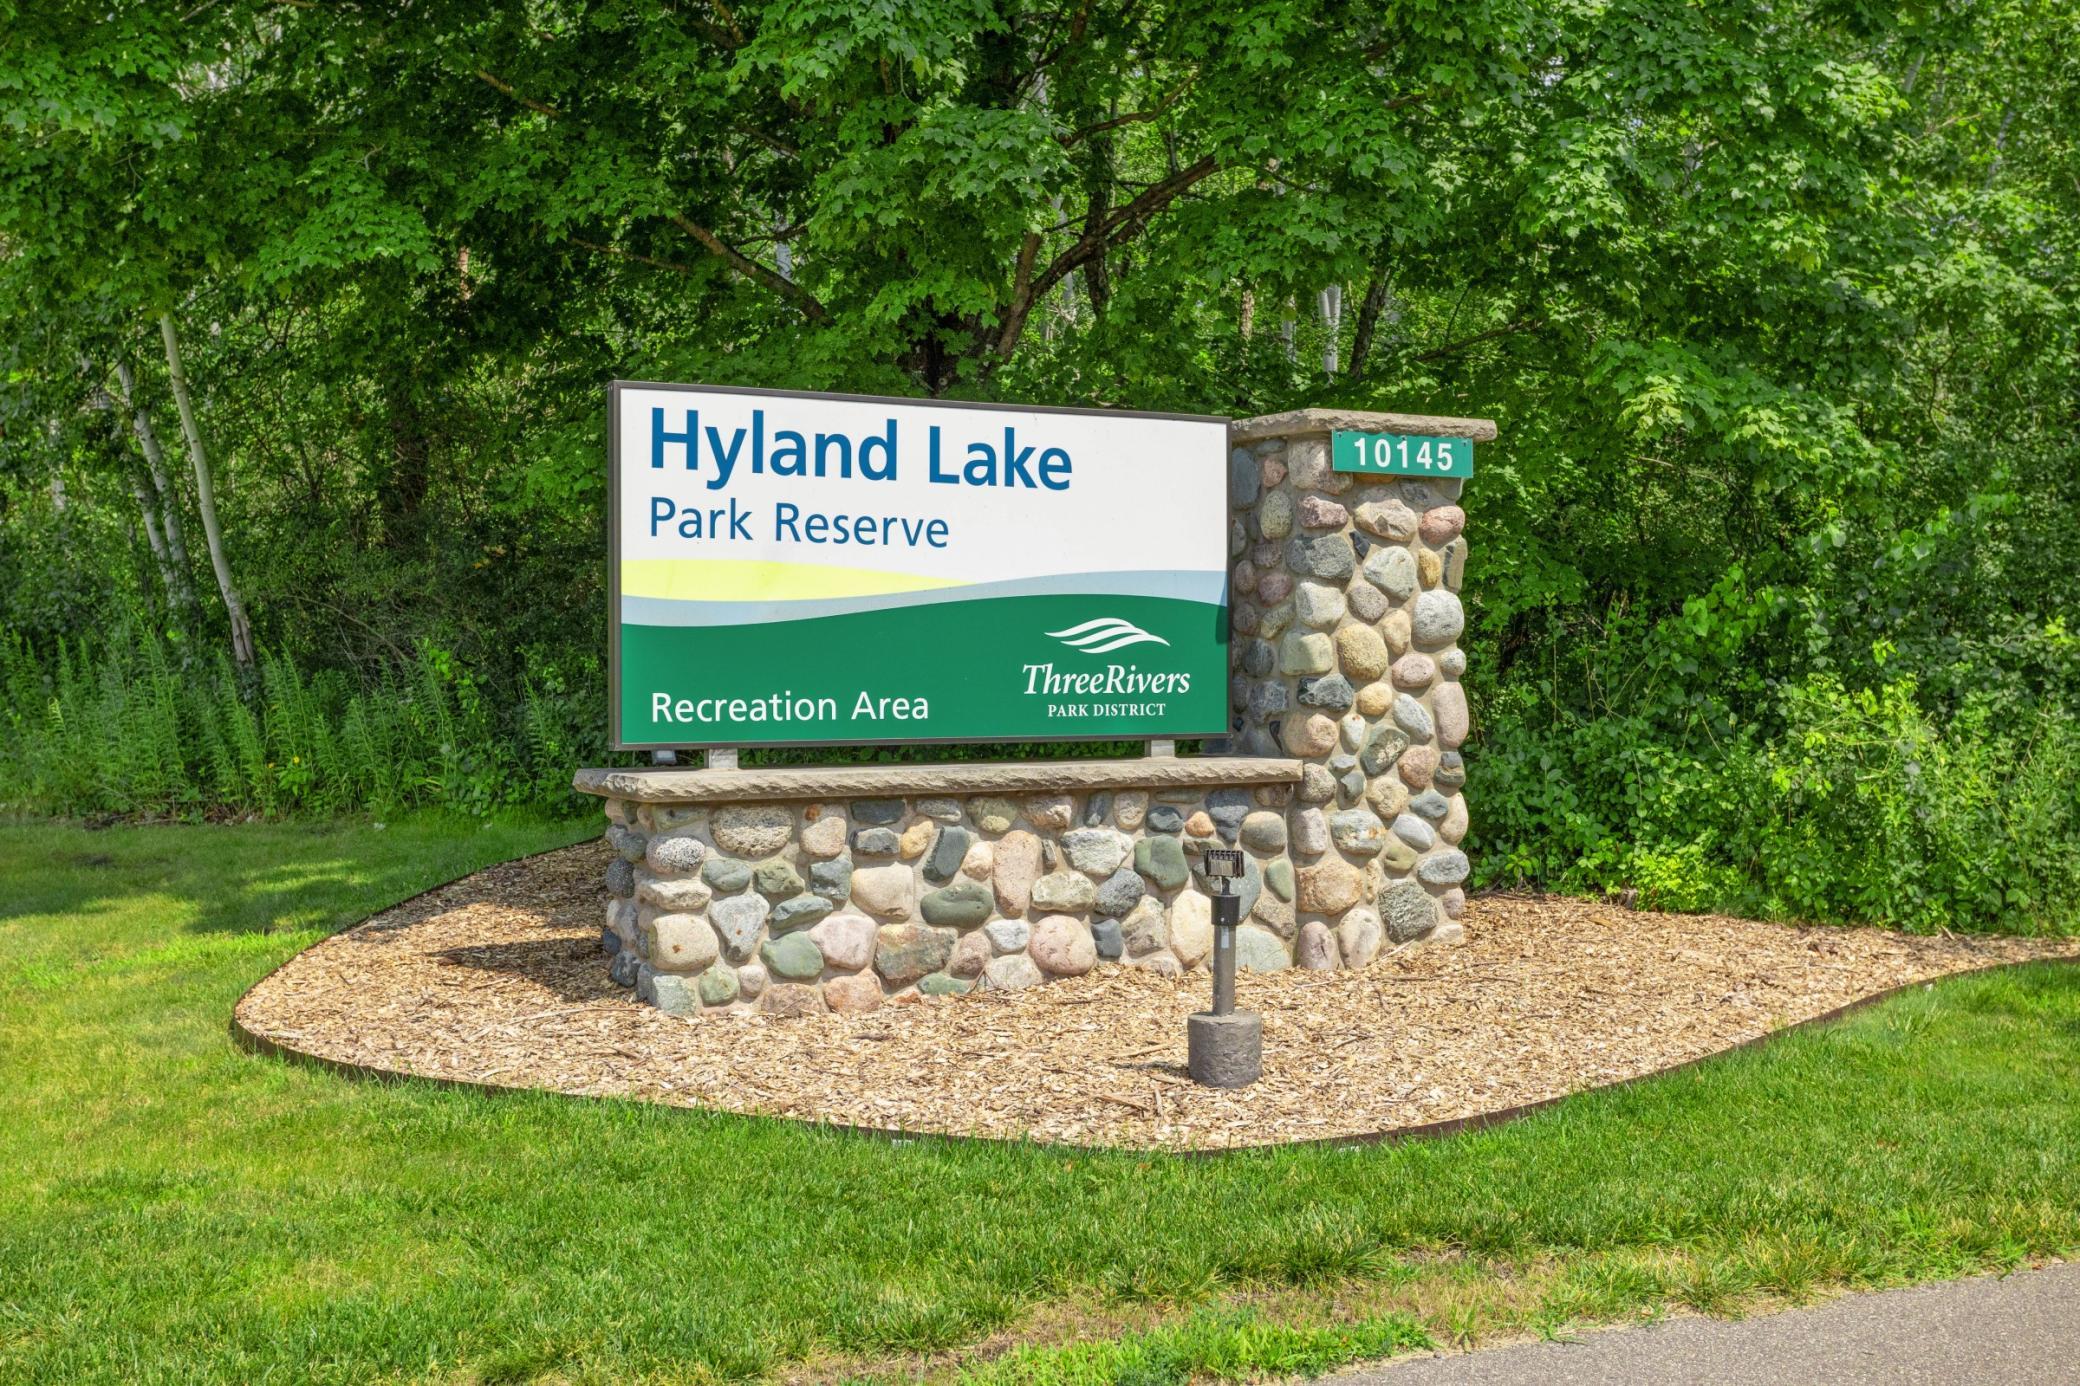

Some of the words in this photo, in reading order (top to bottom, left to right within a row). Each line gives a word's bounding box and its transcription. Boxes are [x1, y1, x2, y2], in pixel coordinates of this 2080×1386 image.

[652, 407, 898, 490] Hyland
[929, 425, 1073, 491] Lake
[1354, 437, 1453, 471] 10145
[651, 496, 753, 541] Park
[775, 502, 949, 548] Reserve
[1022, 662, 1191, 695] ThreeRivers
[652, 690, 837, 723] Recreation
[851, 691, 929, 720] Area
[1047, 703, 1089, 717] PARK
[1093, 702, 1166, 717] DISTRICT
